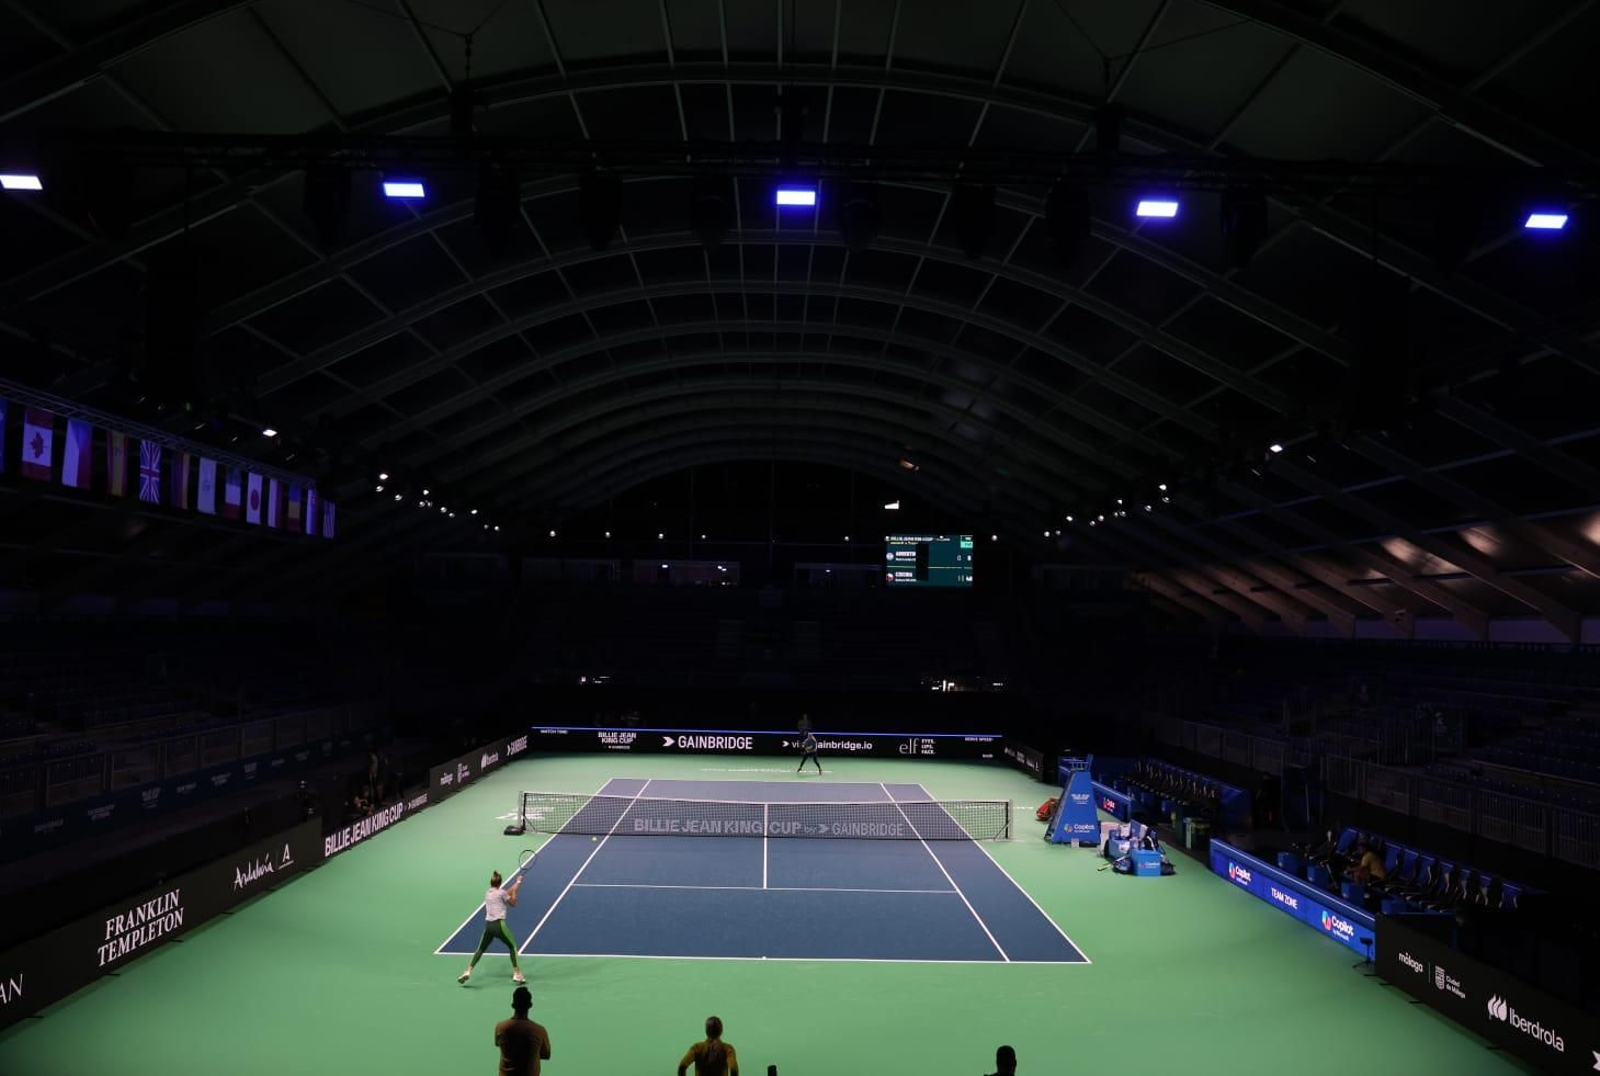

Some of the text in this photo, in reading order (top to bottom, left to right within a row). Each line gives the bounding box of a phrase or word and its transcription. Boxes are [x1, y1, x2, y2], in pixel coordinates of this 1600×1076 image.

[678, 735, 754, 750] GAINBRIDGE
[816, 740, 873, 751] ainbridge.io
[899, 738, 919, 755] elf
[325, 828, 351, 857] BILLIE
[351, 818, 372, 843] JEAN
[372, 809, 389, 833] KING
[390, 802, 404, 823] CUP
[634, 818, 680, 832] BILLIE
[681, 819, 721, 833] JEAN
[724, 821, 763, 834] KING
[769, 822, 801, 834] CUP
[832, 823, 903, 836] GAINBRIDGE
[1271, 887, 1298, 910] TEAM ZONE
[105, 888, 180, 941] FRANKLIN
[1331, 915, 1355, 937] Copilot
[97, 907, 185, 967] TEMPLETON
[0, 973, 24, 1005] AN
[1509, 1007, 1565, 1053] Iberdrola
